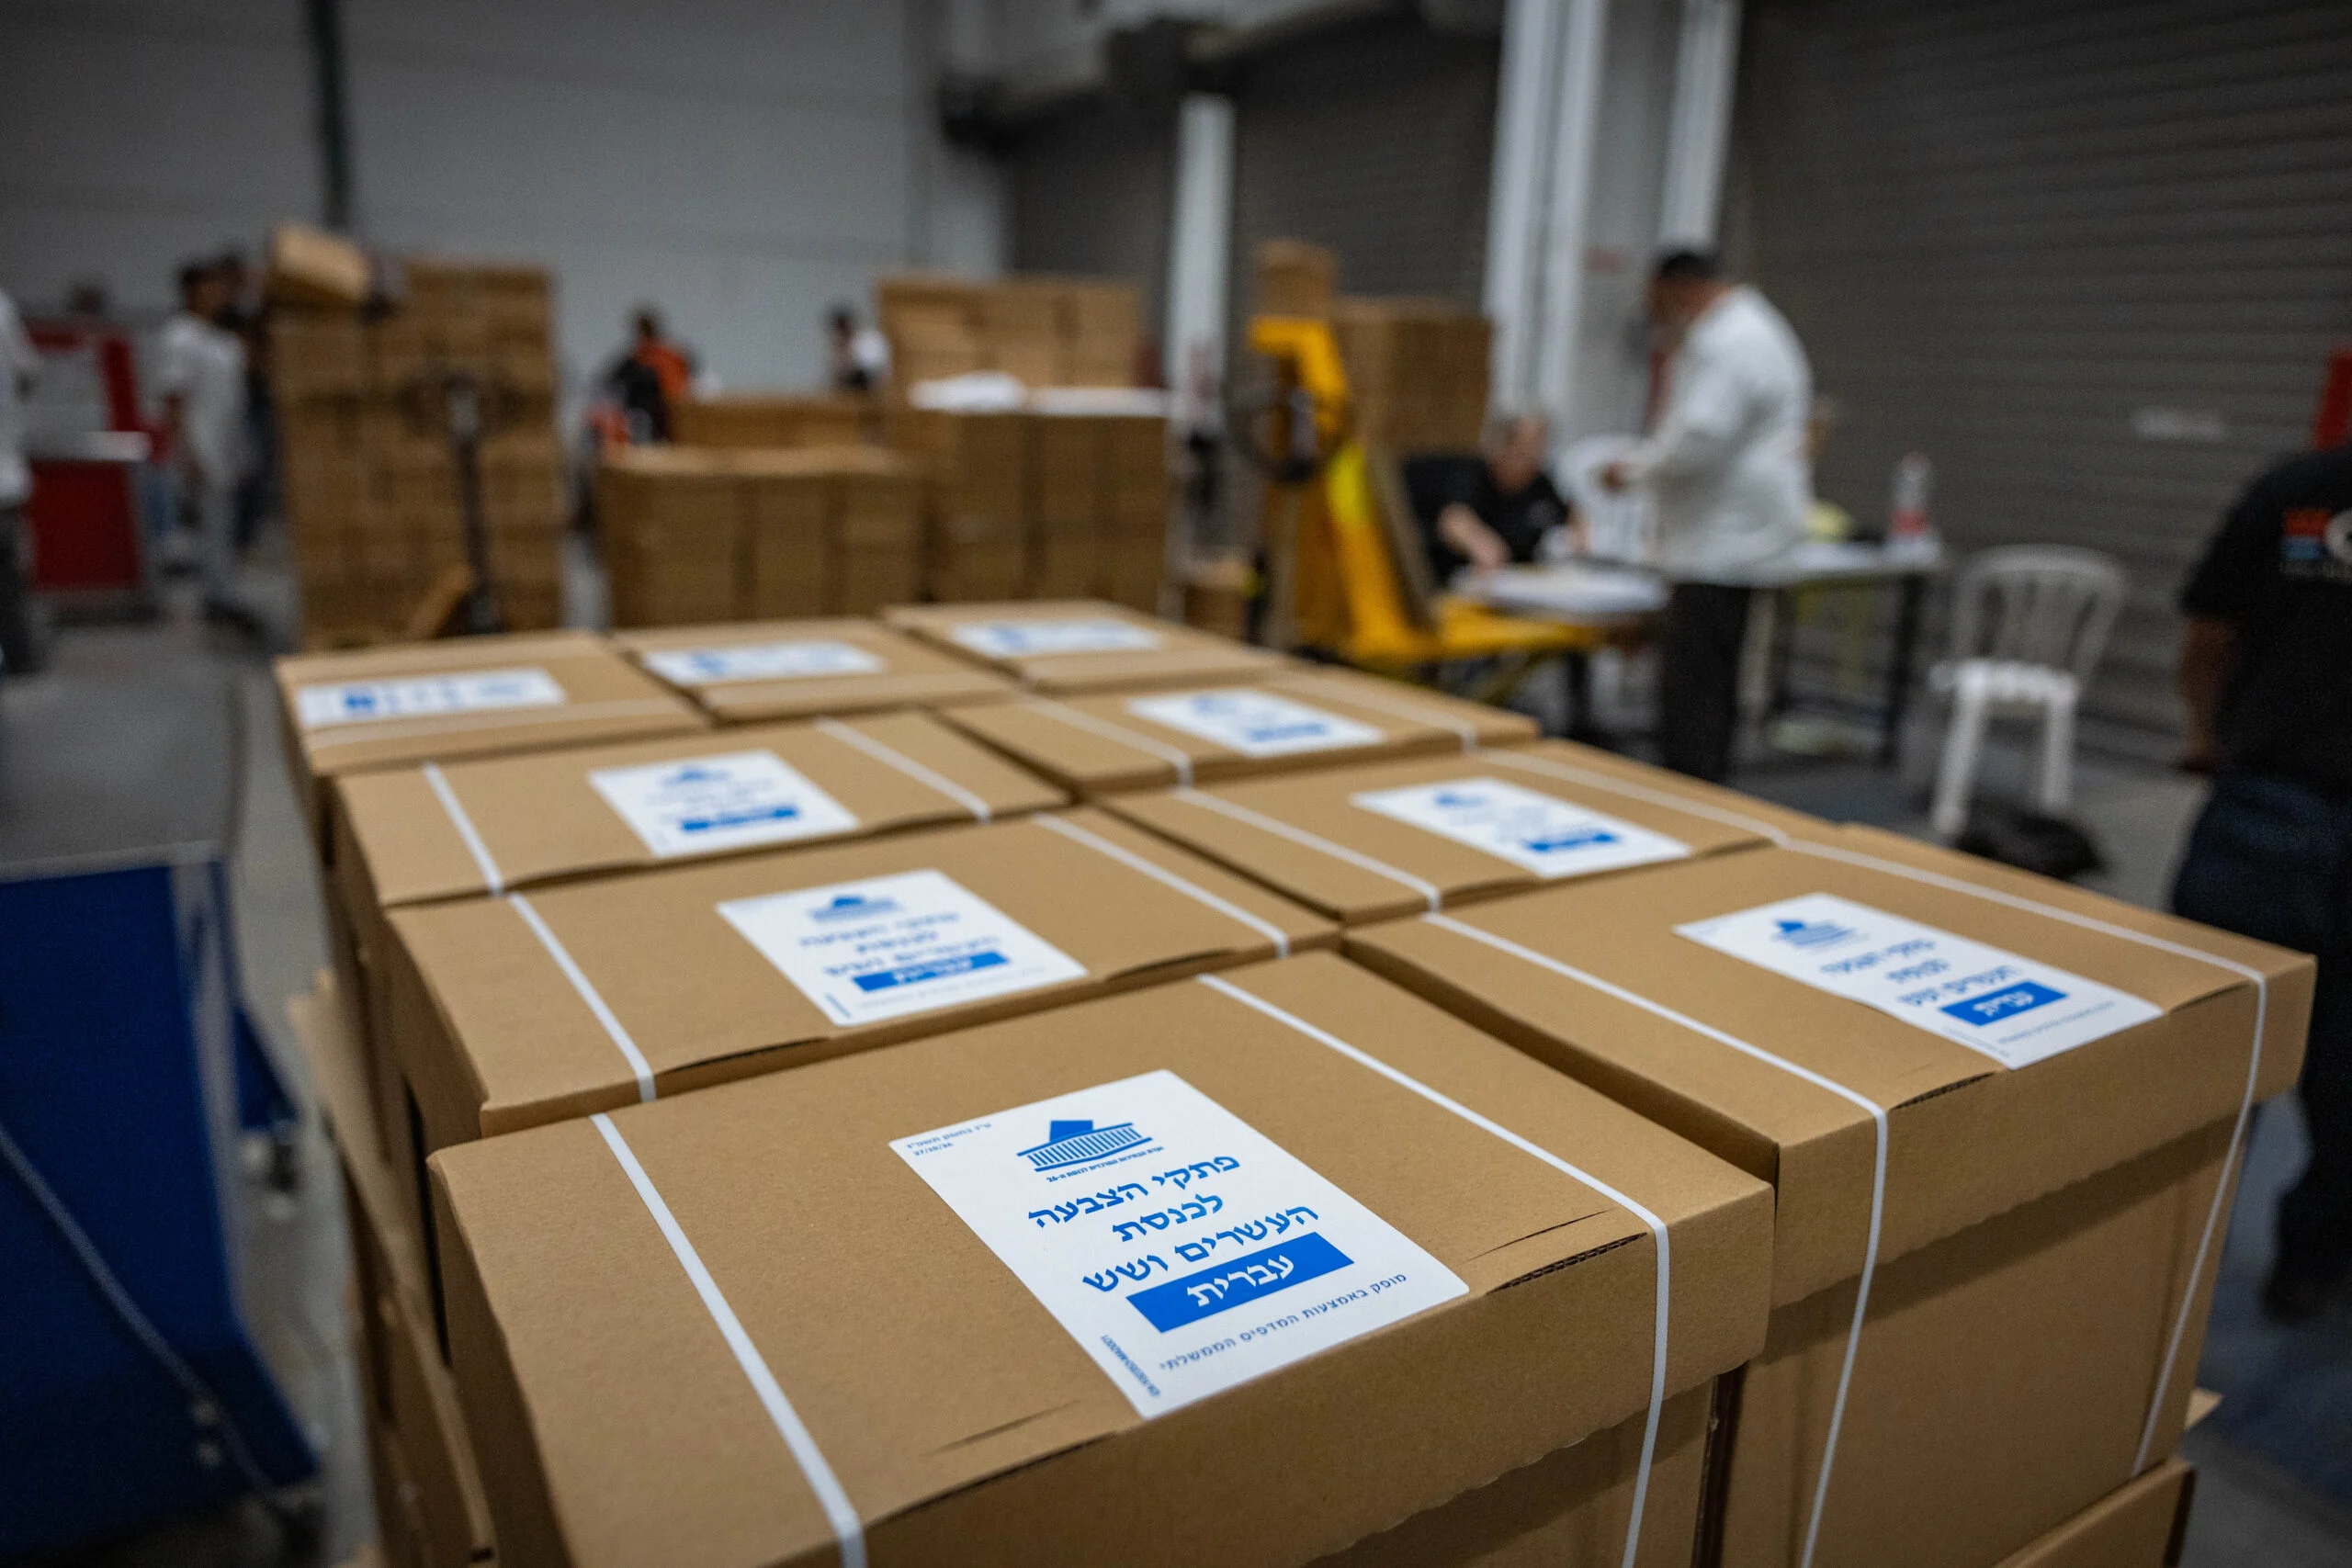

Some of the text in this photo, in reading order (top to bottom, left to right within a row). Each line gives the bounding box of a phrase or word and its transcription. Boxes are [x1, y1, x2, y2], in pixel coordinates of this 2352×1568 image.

[1028, 1156, 1240, 1228] פתקי הצבעה
[1113, 1193, 1223, 1242] לכנסת
[1082, 1205, 1318, 1292] העשרים ושש
[1187, 1254, 1295, 1307] עברית
[1369, 1272, 1408, 1294] מופק
[1301, 1287, 1368, 1319] באמצעות
[1239, 1314, 1299, 1342] המדפיס
[1159, 1338, 1237, 1371] הממשלתי
